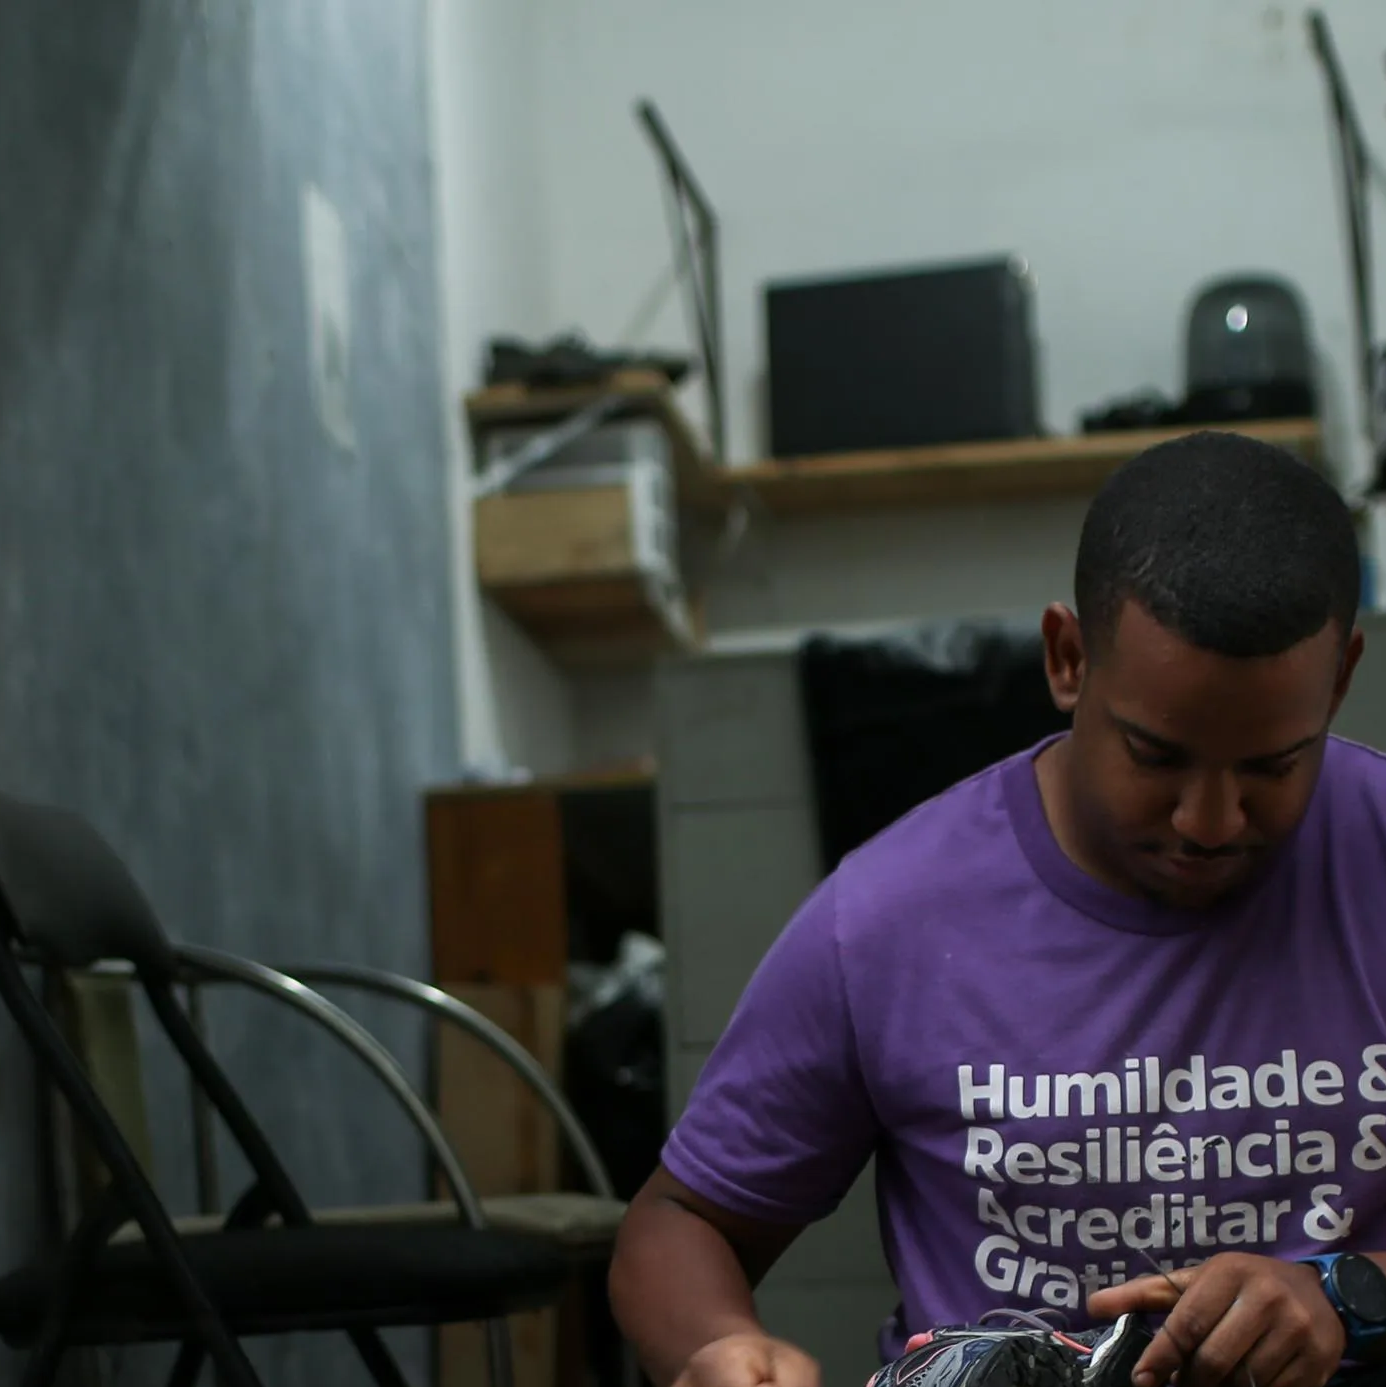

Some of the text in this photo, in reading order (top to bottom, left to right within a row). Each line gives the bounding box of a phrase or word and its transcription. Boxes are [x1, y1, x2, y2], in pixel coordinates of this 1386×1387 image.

[957, 1049, 1345, 1120] Humildade
[964, 1118, 1337, 1184] Resiliência
[977, 1183, 1354, 1250] Acreditar &
